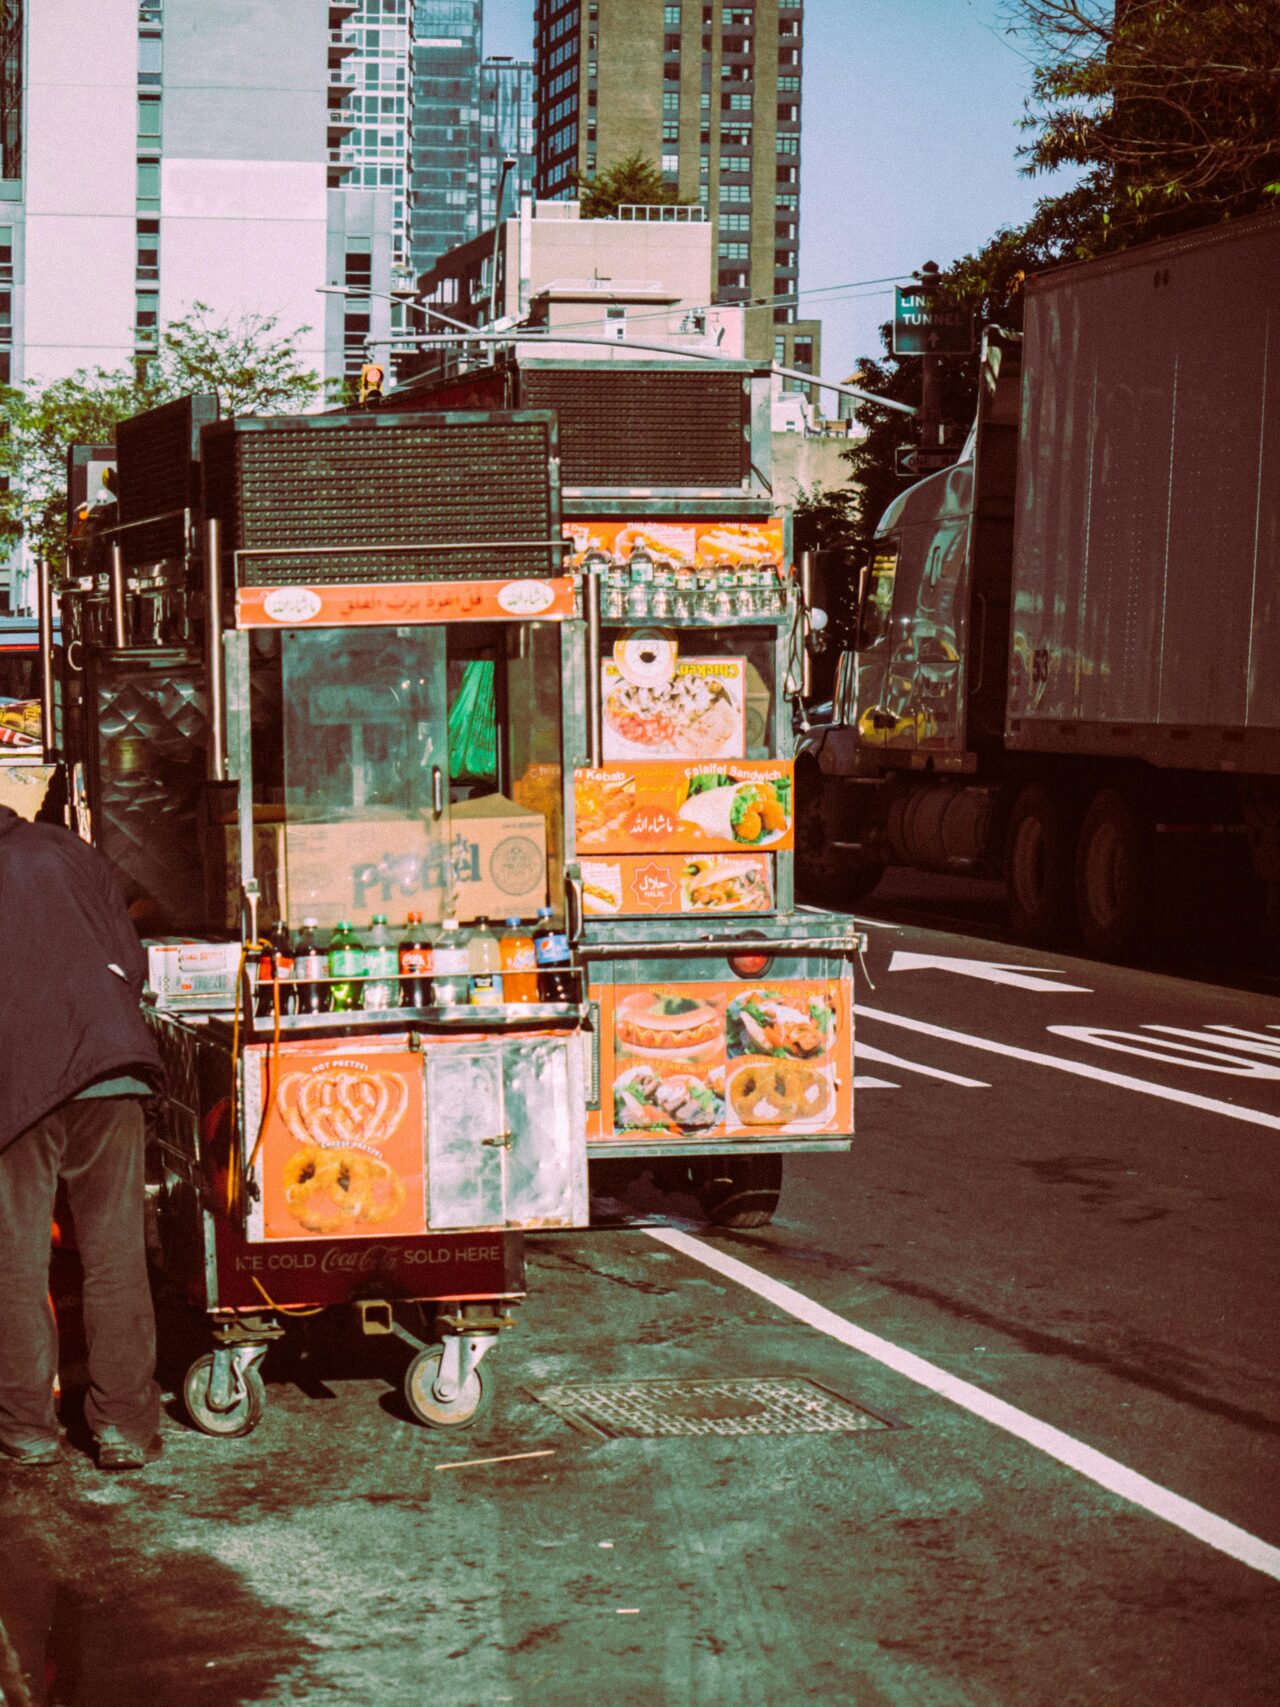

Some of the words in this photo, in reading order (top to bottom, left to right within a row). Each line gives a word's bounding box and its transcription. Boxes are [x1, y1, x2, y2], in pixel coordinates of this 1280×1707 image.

[586, 769, 627, 782] Kebab
[729, 765, 782, 782] Sandwich
[639, 874, 669, 892] حلال
[644, 890, 665, 898] HALAL
[311, 1061, 330, 1073] HOT
[332, 1060, 369, 1072] PRETZEL
[267, 1253, 317, 1270] COLD
[403, 1249, 451, 1265] SOLD
[455, 1246, 501, 1263] HERE
